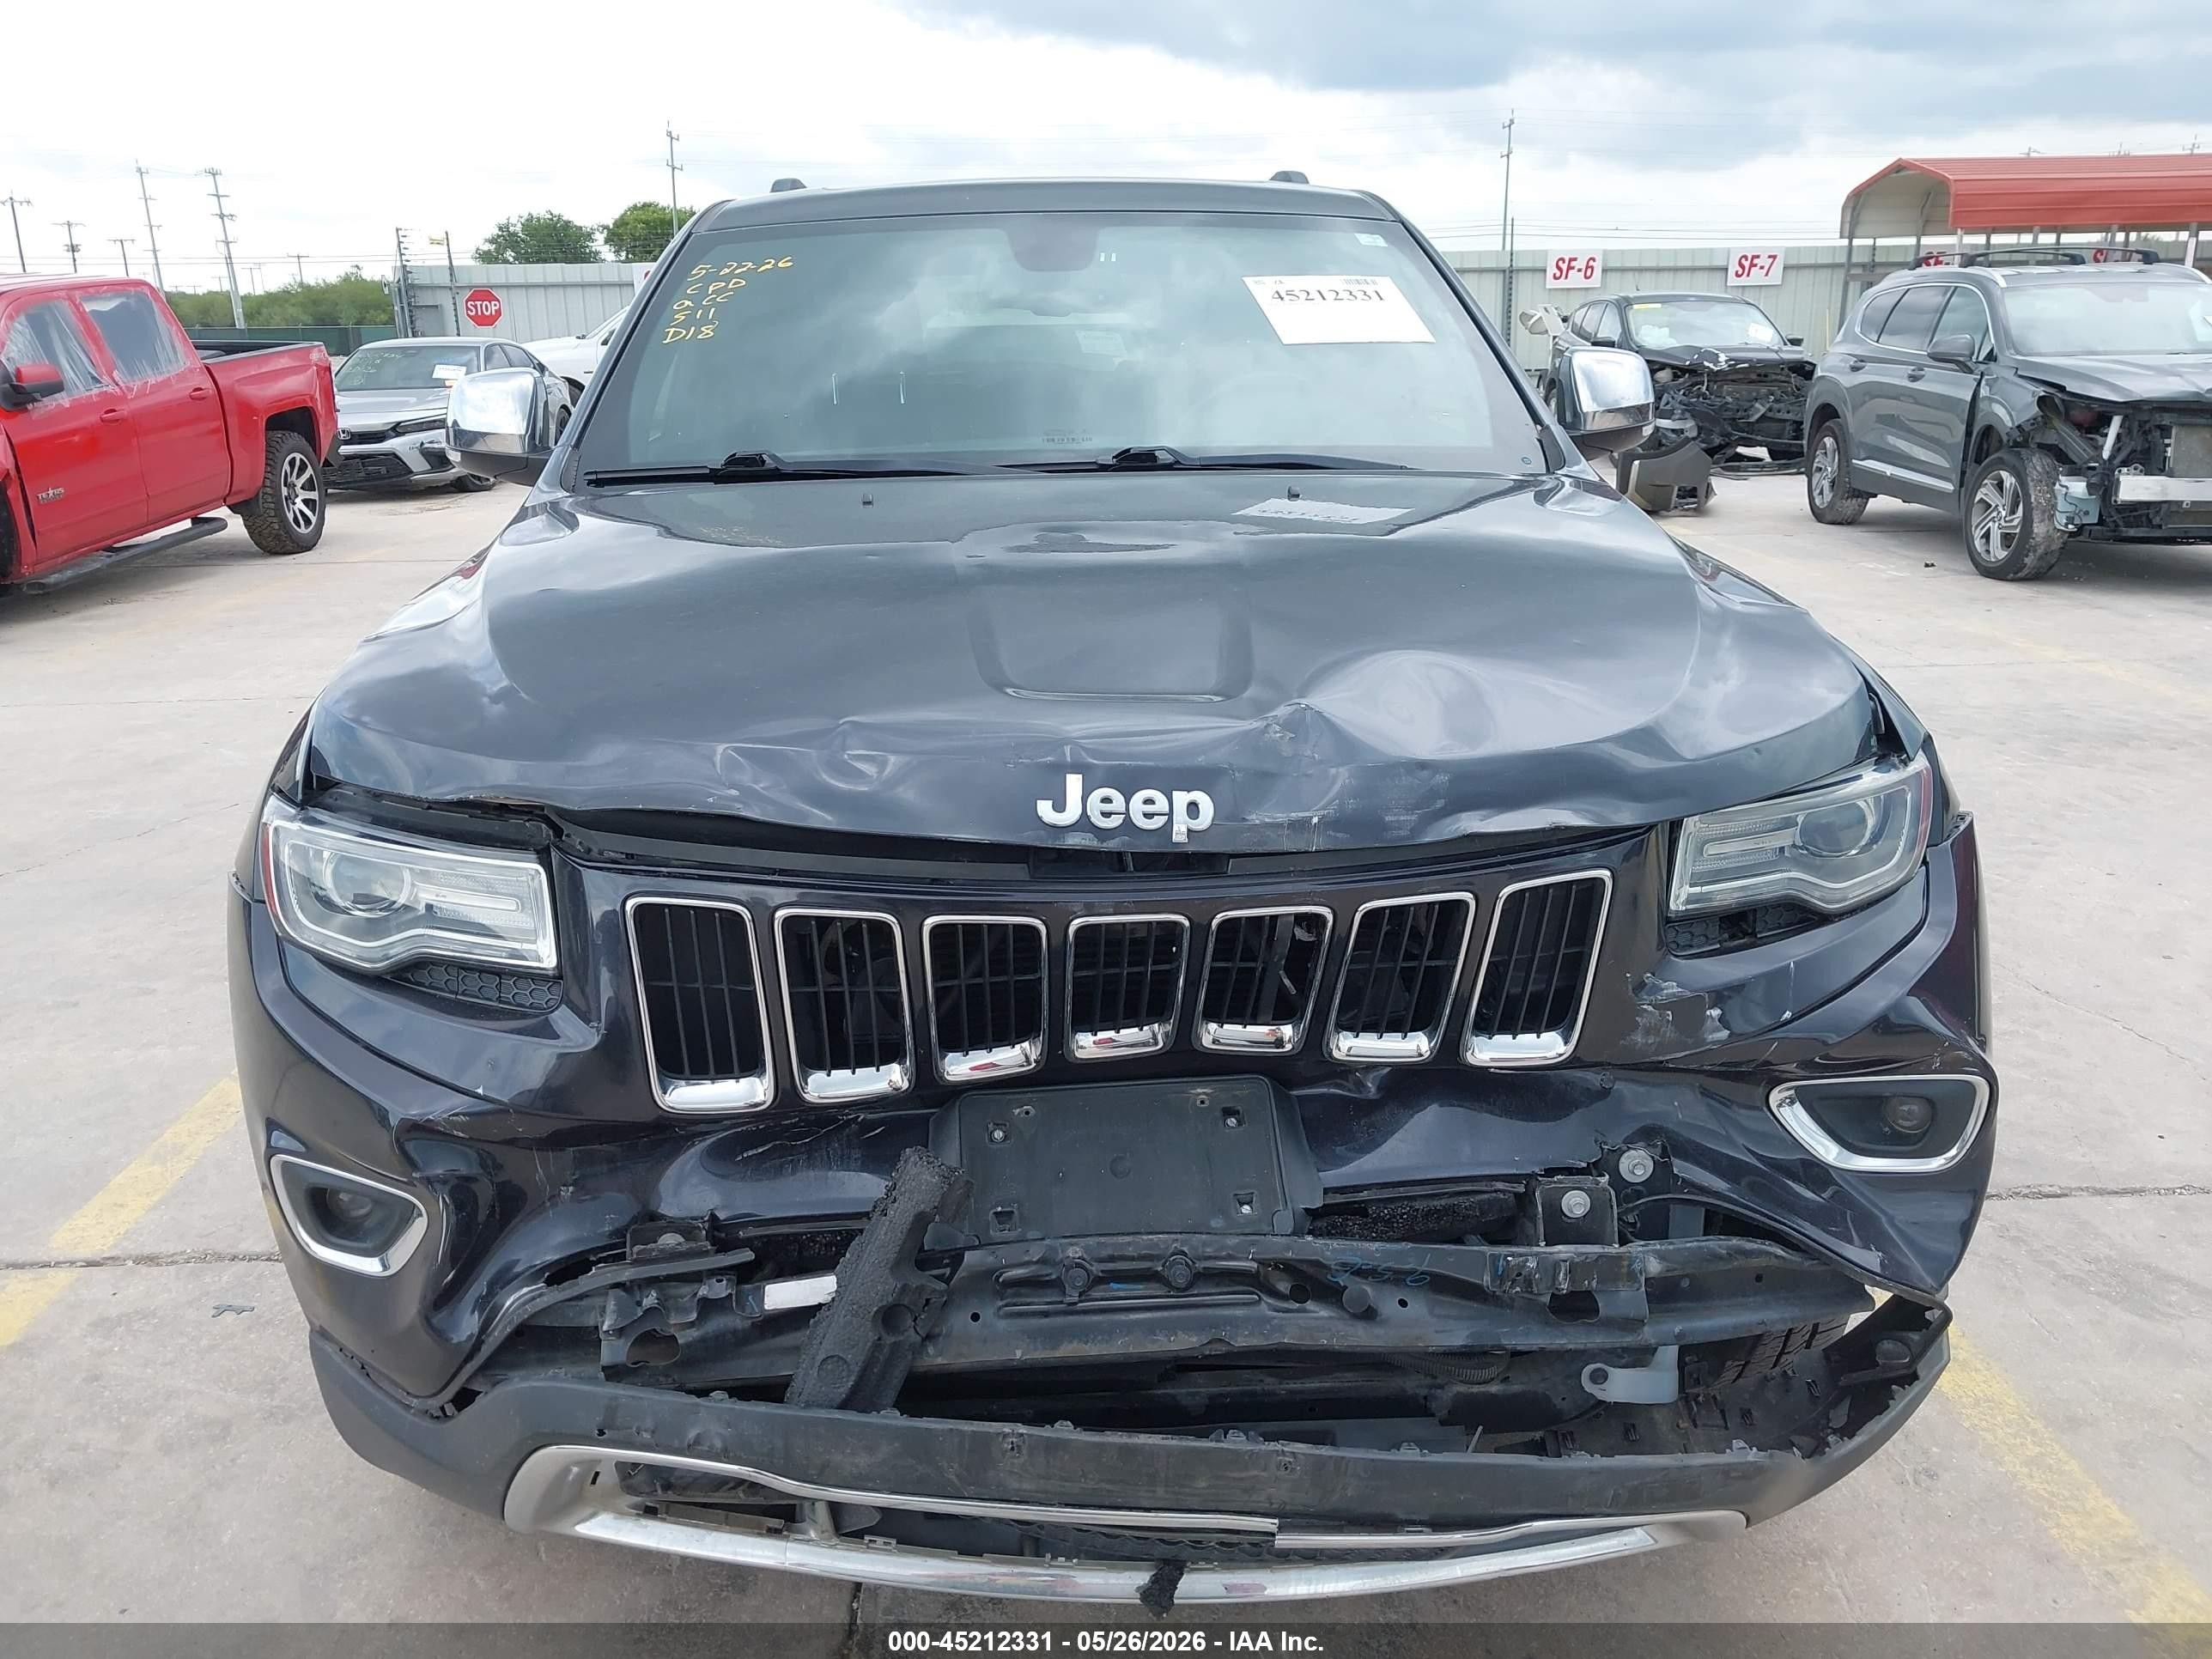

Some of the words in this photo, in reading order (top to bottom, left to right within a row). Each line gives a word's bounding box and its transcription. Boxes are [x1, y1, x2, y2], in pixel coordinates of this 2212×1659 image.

[1553, 257, 1596, 281] SF-6
[1735, 254, 1778, 278] SF-7
[1271, 289, 1384, 301] 45212331
[467, 301, 500, 316] STOP
[1036, 773, 1215, 843] Jeep
